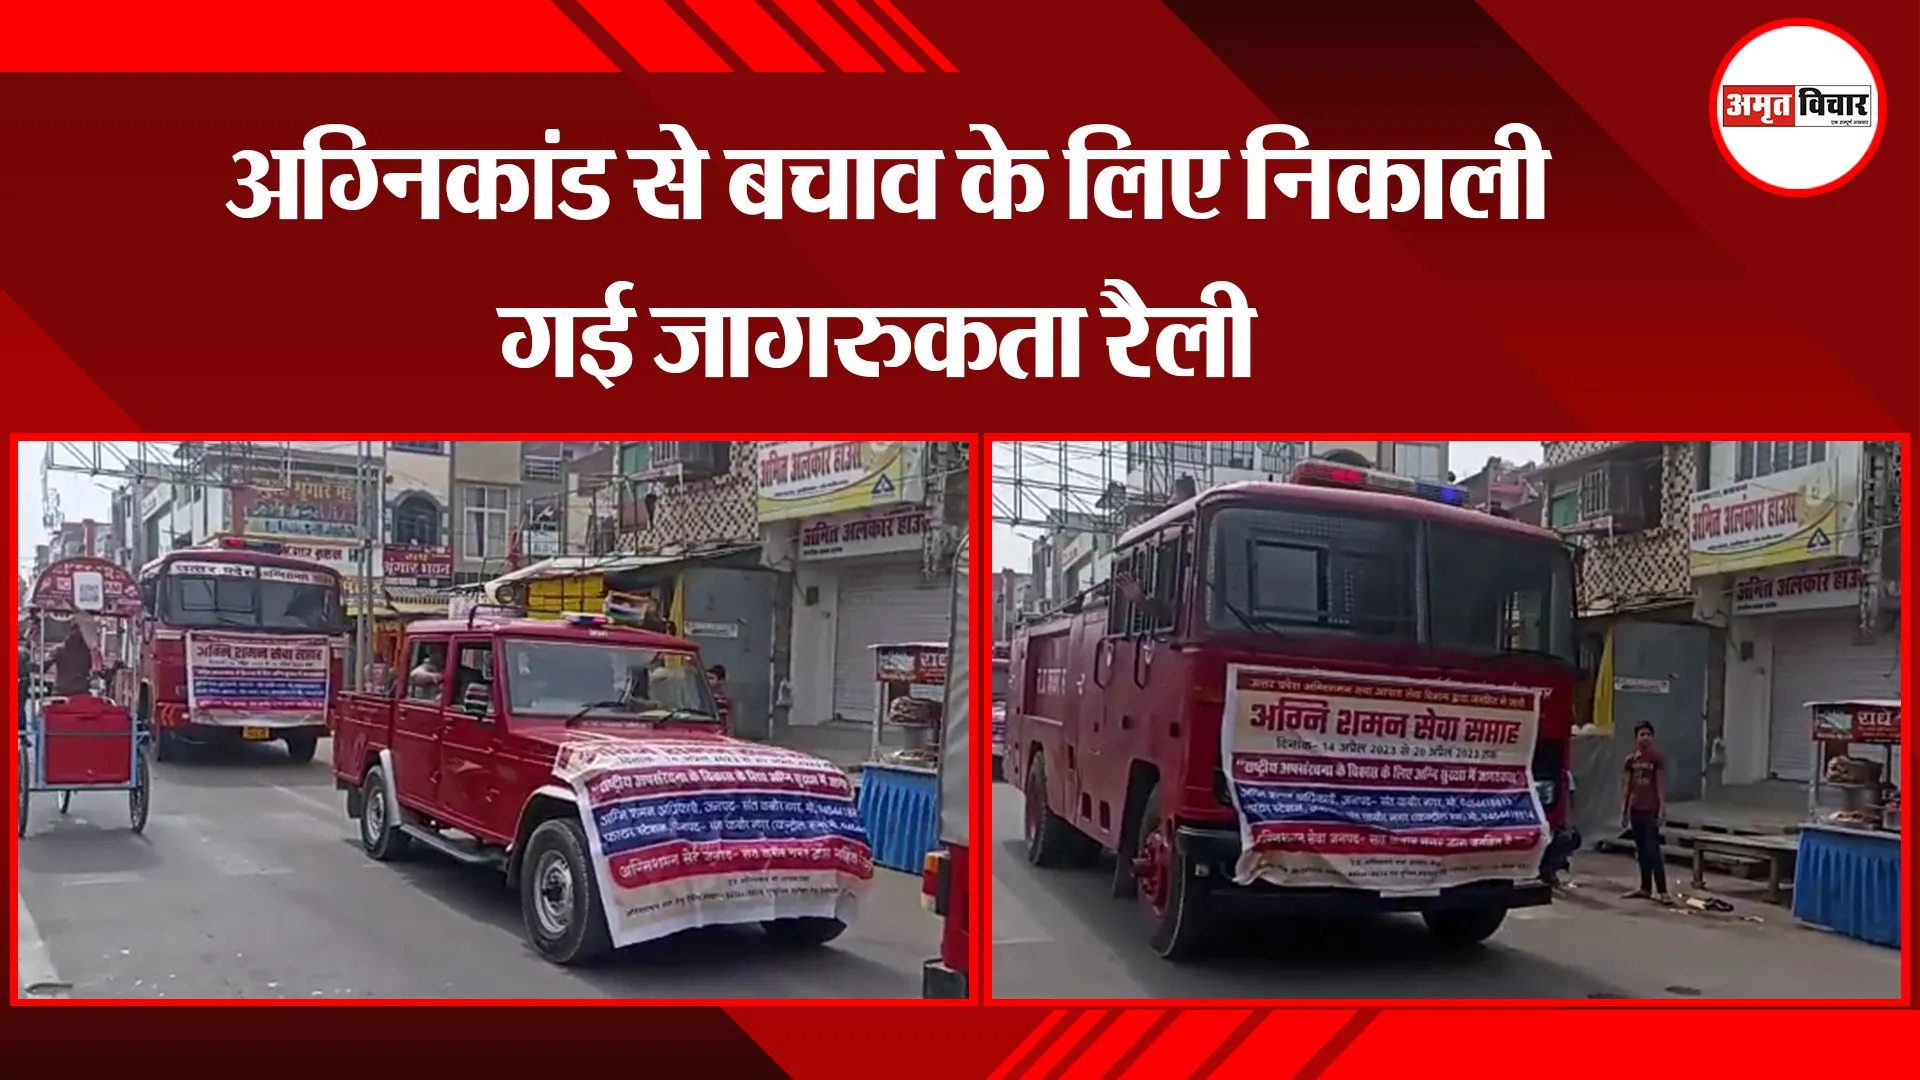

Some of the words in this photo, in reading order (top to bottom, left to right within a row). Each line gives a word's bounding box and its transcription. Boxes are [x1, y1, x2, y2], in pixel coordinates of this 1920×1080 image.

[760, 450, 788, 488] अमित
[803, 519, 840, 546] अमित
[1692, 503, 1721, 541] अमित
[1737, 575, 1773, 601] अमित
[1250, 695, 1331, 735] अग्नि
[1336, 708, 1410, 739] शमन
[1414, 706, 1461, 742] सेवा
[1463, 717, 1523, 745] सप्ताह
[1323, 742, 1335, 751] 14
[1371, 745, 1397, 756] 2023
[1413, 746, 1426, 757] 20
[1455, 749, 1480, 760] 2023
[1335, 763, 1346, 778] के
[1347, 762, 1378, 780] विकास
[1380, 764, 1391, 779] के
[1392, 762, 1412, 780] लिए
[1414, 764, 1438, 781] अग्नि
